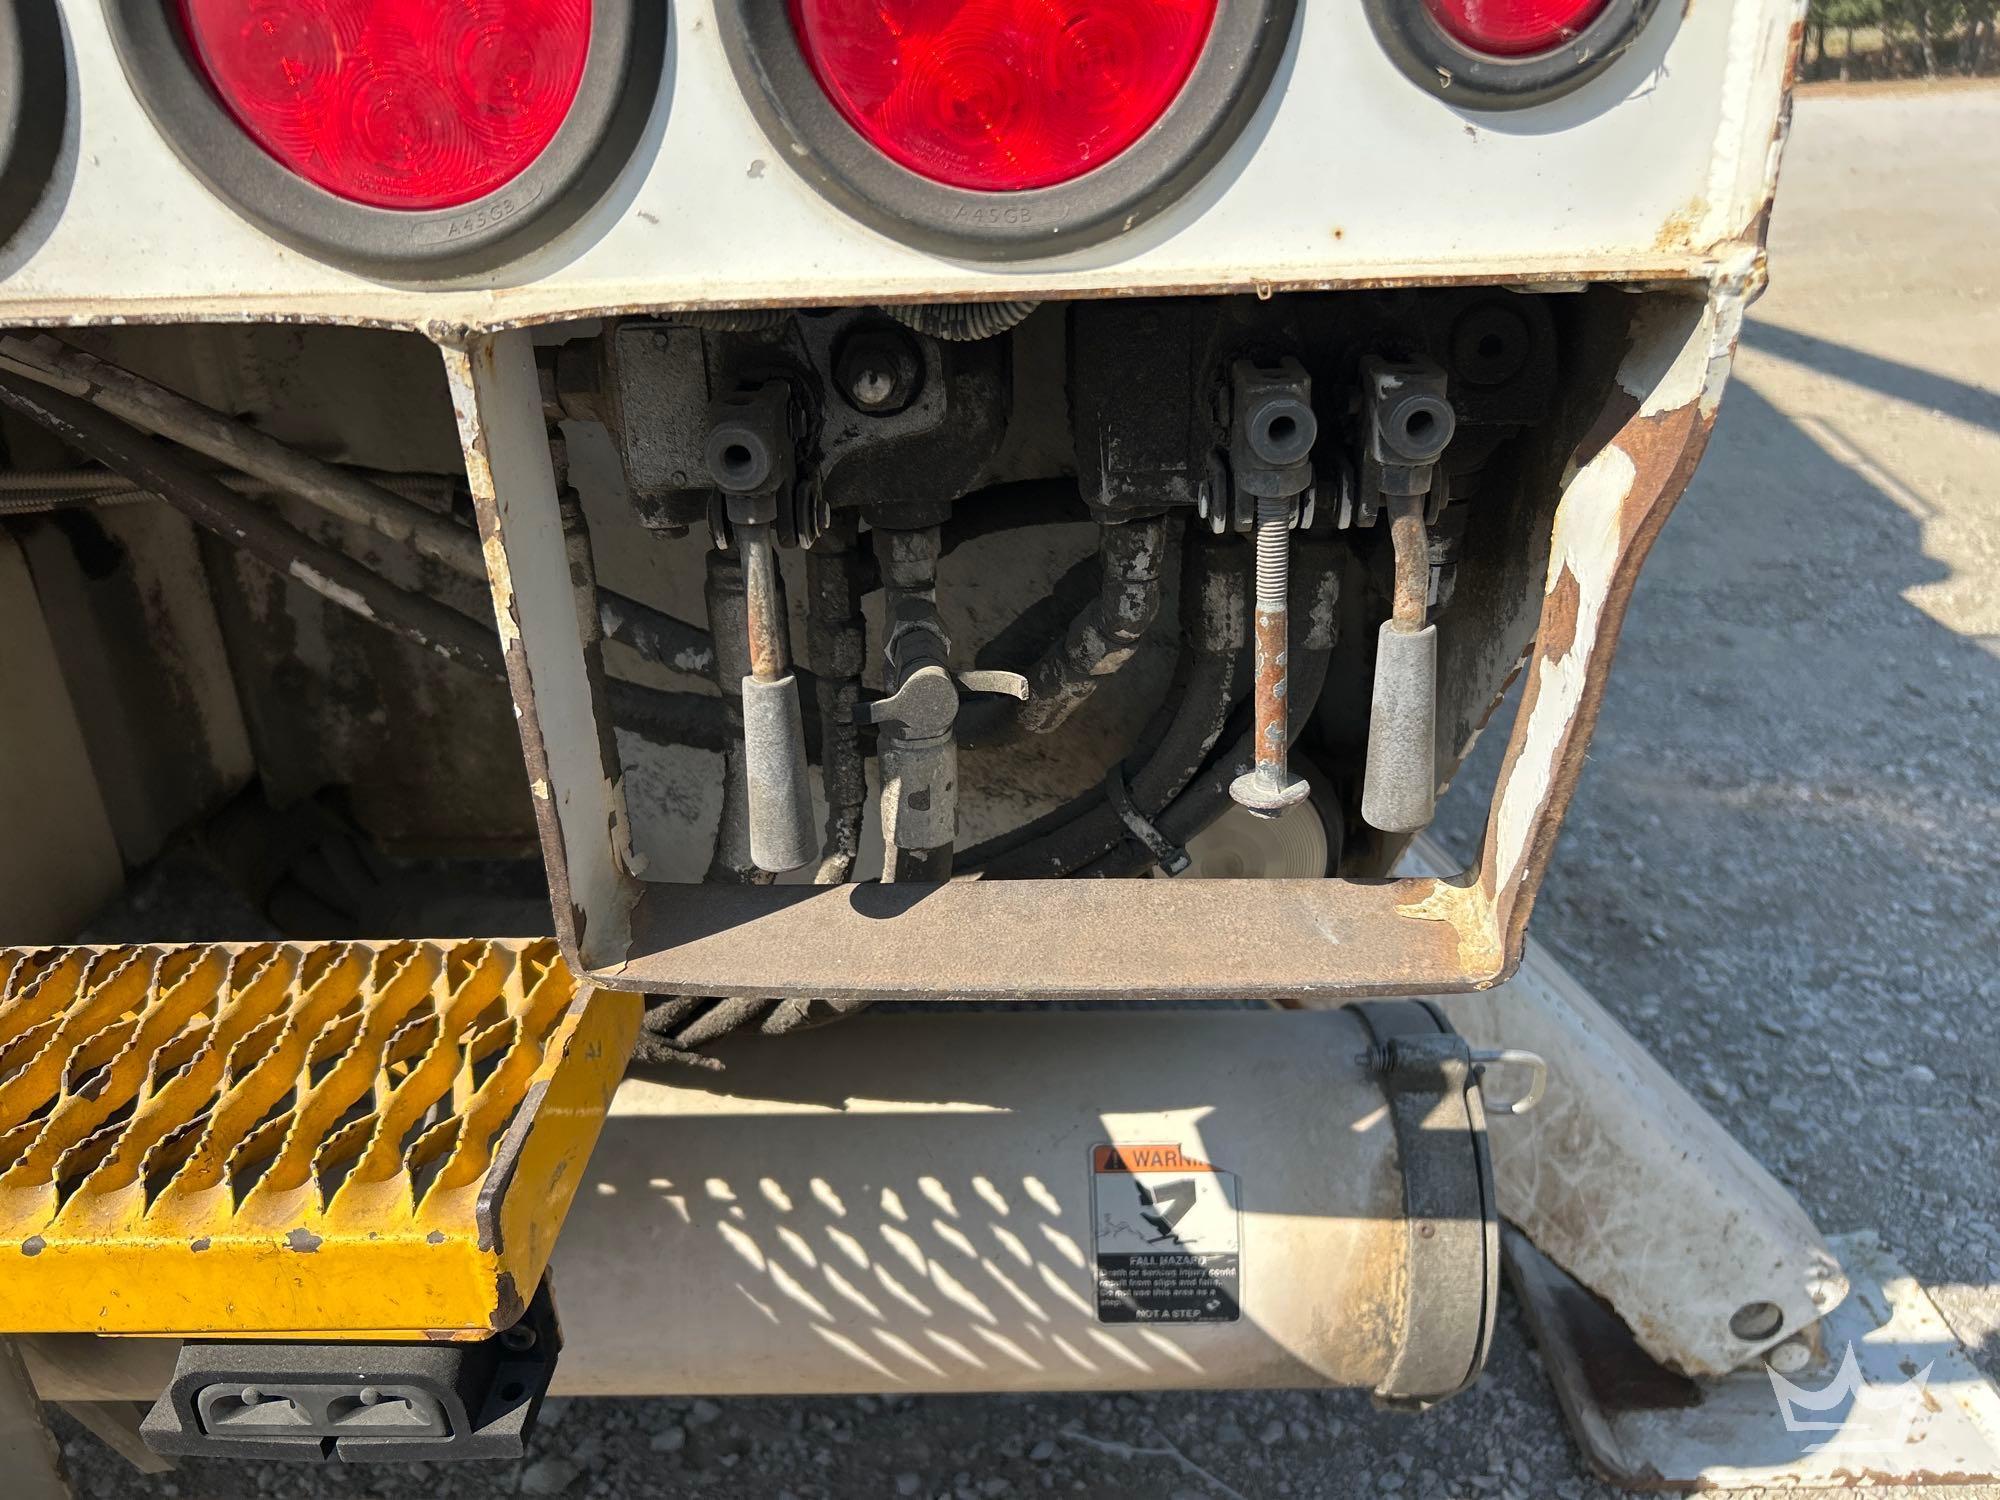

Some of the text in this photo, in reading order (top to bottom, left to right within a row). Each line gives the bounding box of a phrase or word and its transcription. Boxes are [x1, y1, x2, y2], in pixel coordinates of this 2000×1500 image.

[1136, 1309, 1159, 1319] NOT
[1161, 1309, 1171, 1319] A
[1171, 1308, 1201, 1319] STEP
